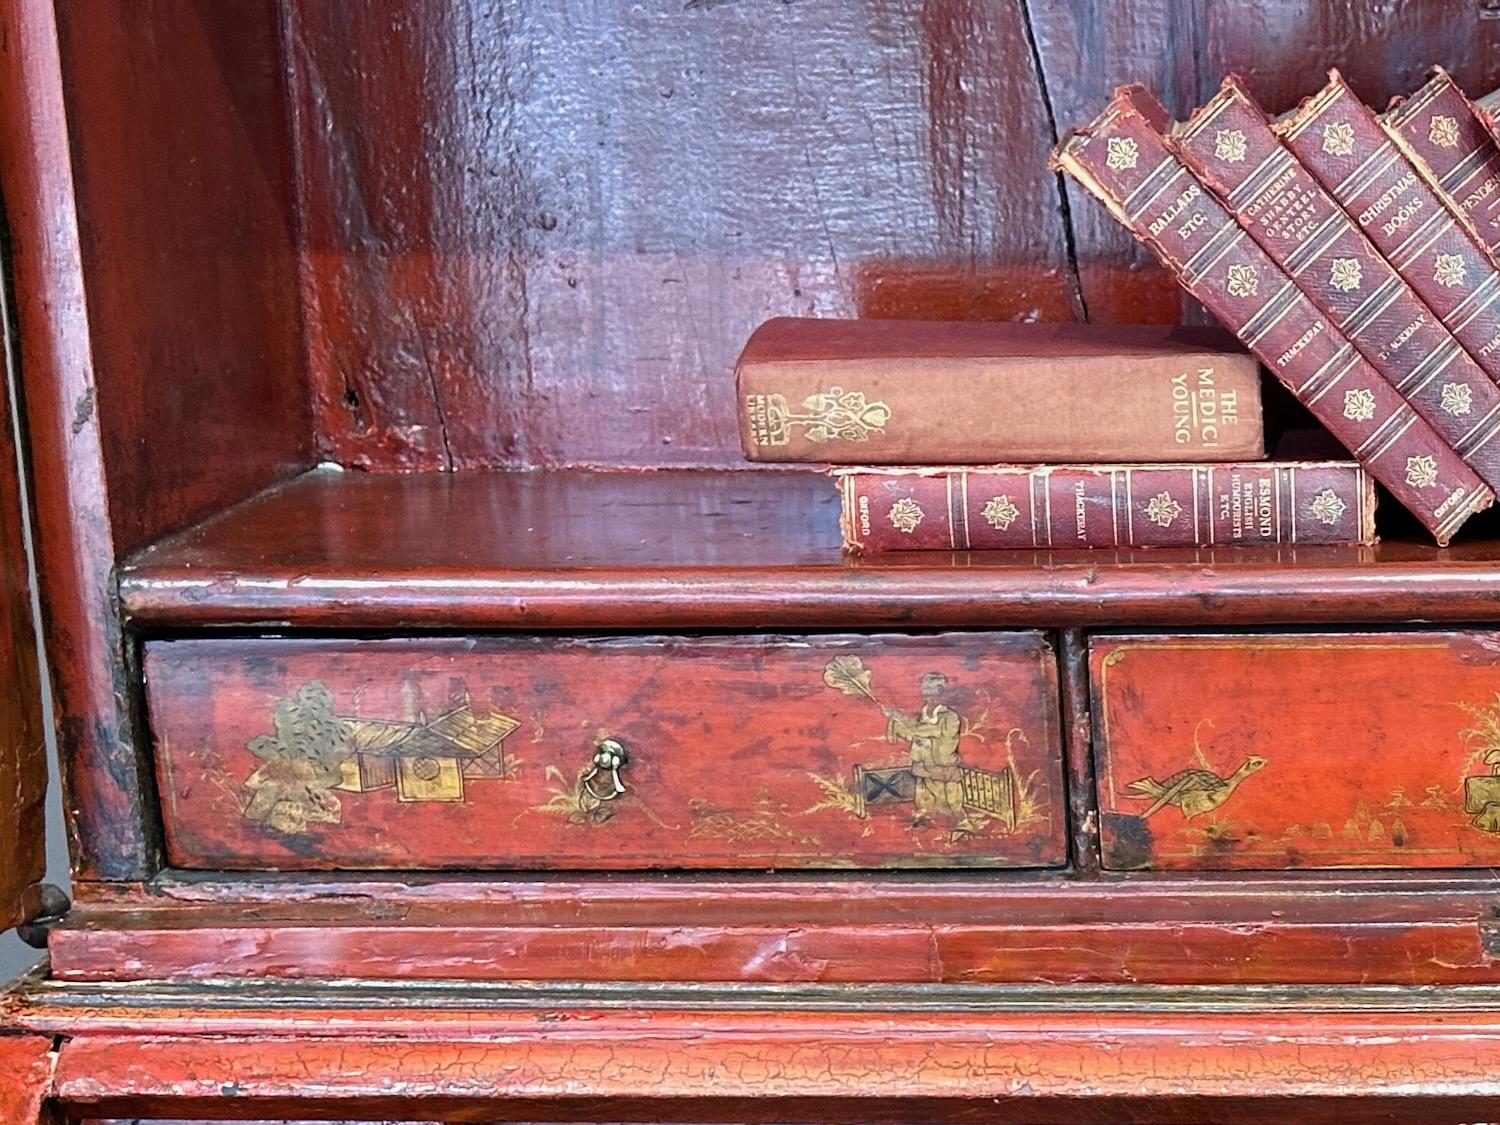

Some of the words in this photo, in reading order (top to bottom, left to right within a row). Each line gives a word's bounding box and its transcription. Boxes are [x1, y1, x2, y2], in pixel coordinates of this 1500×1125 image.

[1148, 184, 1201, 236] BALLADS
[1247, 167, 1297, 216] CATHERINE
[1260, 183, 1302, 226] SHABBY
[1265, 189, 1316, 237] GENTEEL
[1358, 170, 1417, 226] CHRISTMAS
[1281, 203, 1316, 239] STORY
[1381, 196, 1424, 236] BOOKS
[1276, 320, 1325, 367] THACKERAY
[756, 394, 769, 446] MODERN
[1171, 373, 1191, 444] YOUNG
[1198, 367, 1218, 447] MEDICI
[1220, 389, 1239, 425] THE
[859, 495, 870, 536] OXFORD
[1074, 480, 1087, 541] THACKERAY
[1231, 474, 1242, 539] HUMOURISTS
[1243, 482, 1254, 530] ENGLISH
[1259, 478, 1272, 537] ESMOND
[1433, 487, 1466, 518] OXFORD
